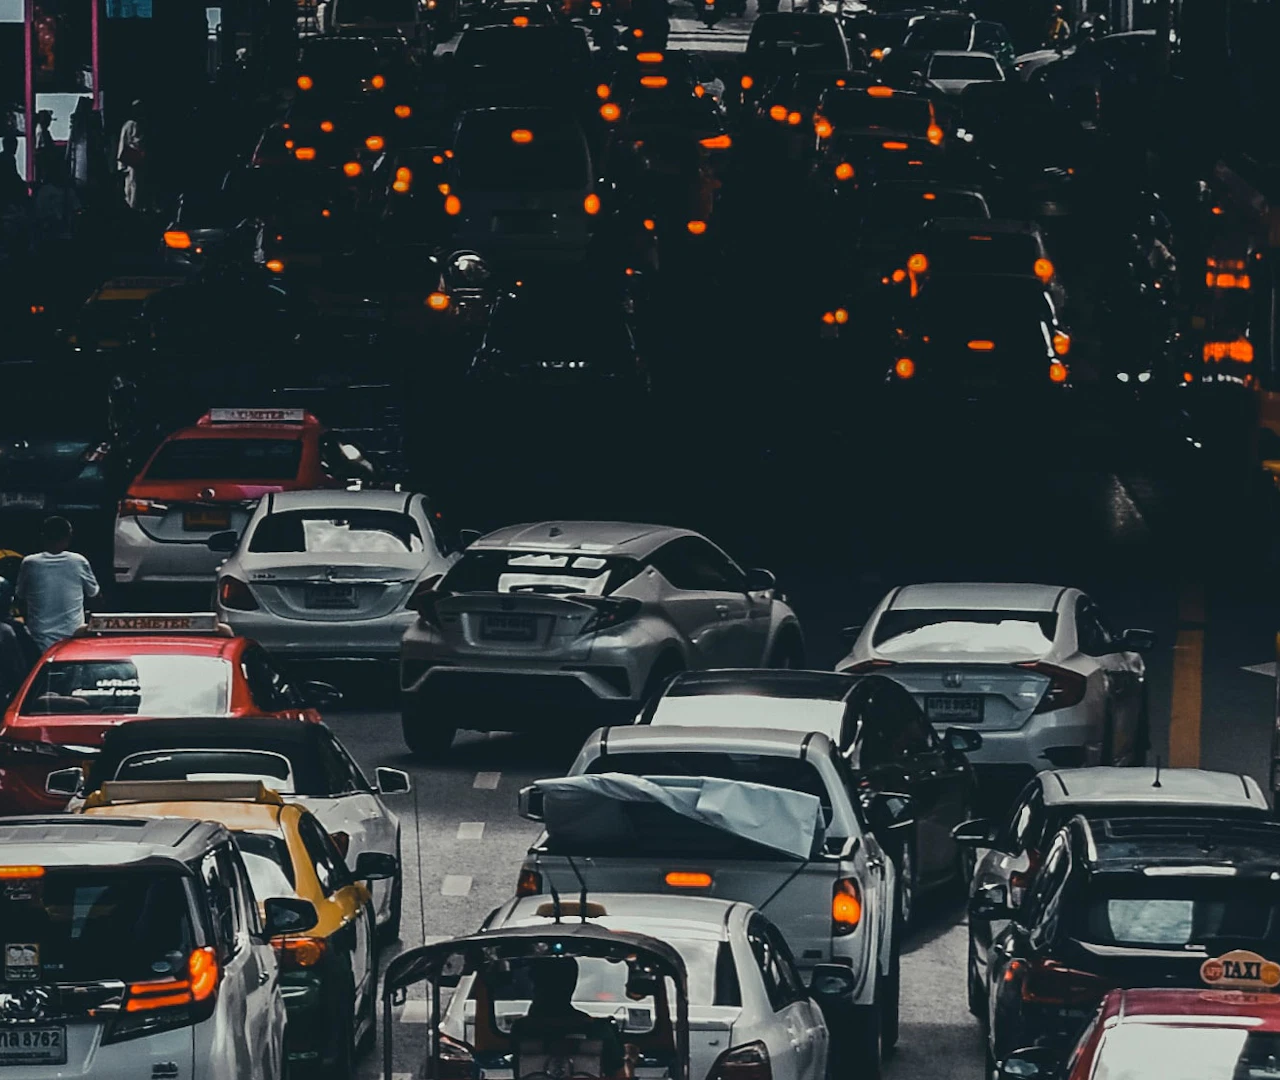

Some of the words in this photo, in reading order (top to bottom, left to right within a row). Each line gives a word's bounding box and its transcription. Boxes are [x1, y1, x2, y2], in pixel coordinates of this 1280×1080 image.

[104, 618, 190, 630] TAXI-METER
[1223, 960, 1262, 980] TAXI
[23, 1031, 61, 1047] 8762
